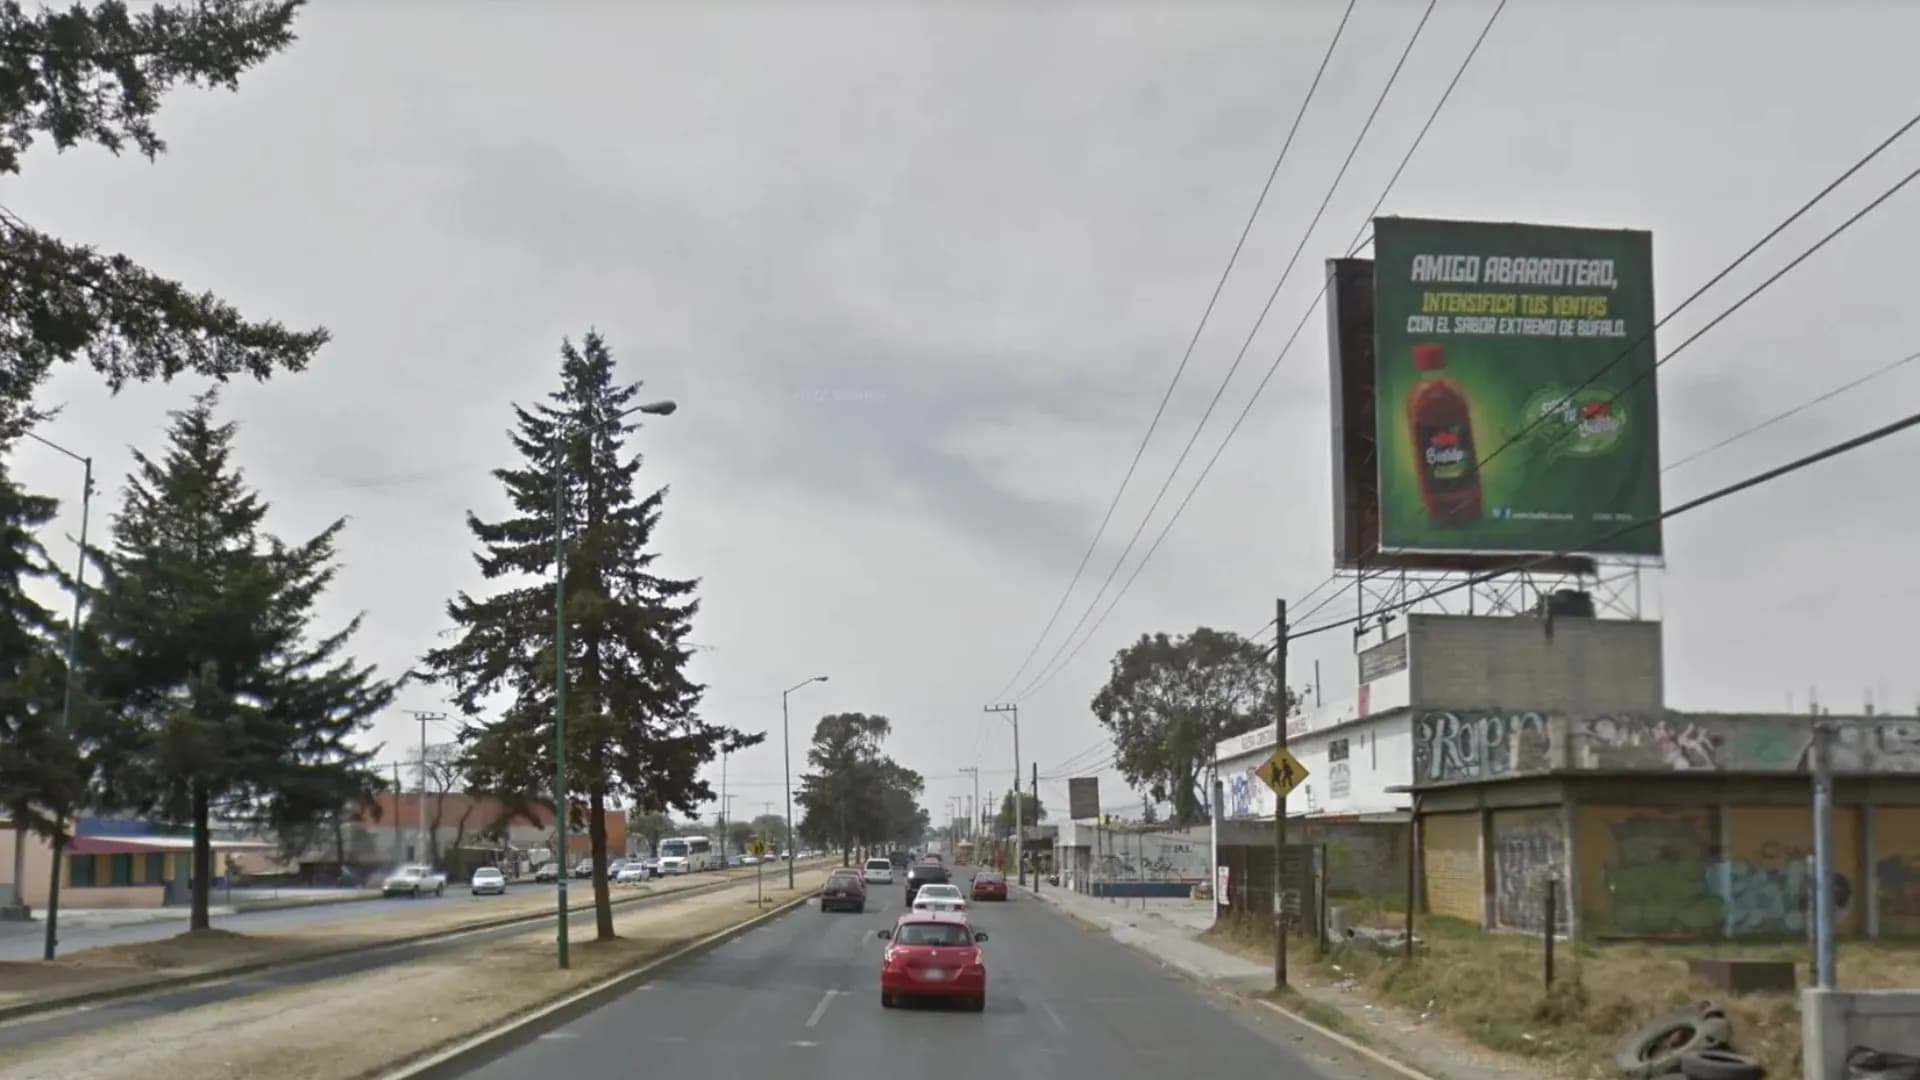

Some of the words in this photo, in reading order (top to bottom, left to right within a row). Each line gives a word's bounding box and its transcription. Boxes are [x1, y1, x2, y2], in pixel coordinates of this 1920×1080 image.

[1410, 254, 1481, 283] AMIGO
[1483, 256, 1618, 290] ABARROTERO,
[1422, 291, 1516, 314] INTENSIFICA
[1520, 294, 1550, 316] TUS
[1552, 295, 1608, 317] VENTAS
[1407, 315, 1434, 333] CON
[1436, 315, 1452, 333] EL
[1454, 316, 1497, 334] SABOR
[1499, 317, 1558, 336] EXTREMO
[1559, 318, 1575, 336] DE
